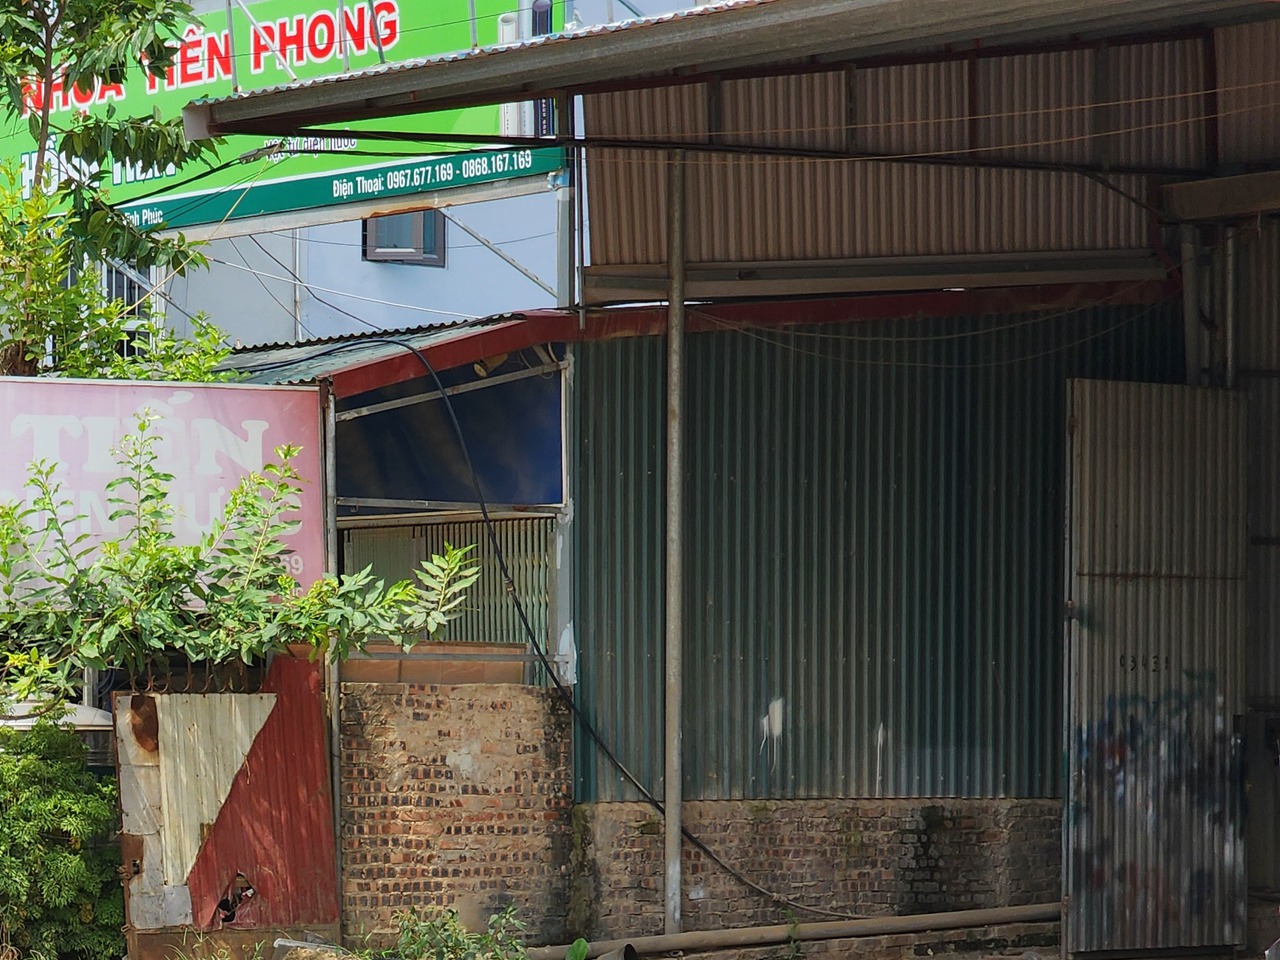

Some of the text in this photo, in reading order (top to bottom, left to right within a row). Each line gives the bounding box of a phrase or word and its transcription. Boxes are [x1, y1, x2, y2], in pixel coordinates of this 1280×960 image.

[252, 2, 398, 71] PHONG
[332, 179, 353, 199] Điện
[356, 173, 384, 196] Thoại:
[387, 162, 454, 189] 0967.677.169
[462, 150, 532, 178] 0868.167.169
[142, 207, 164, 225] Phúc
